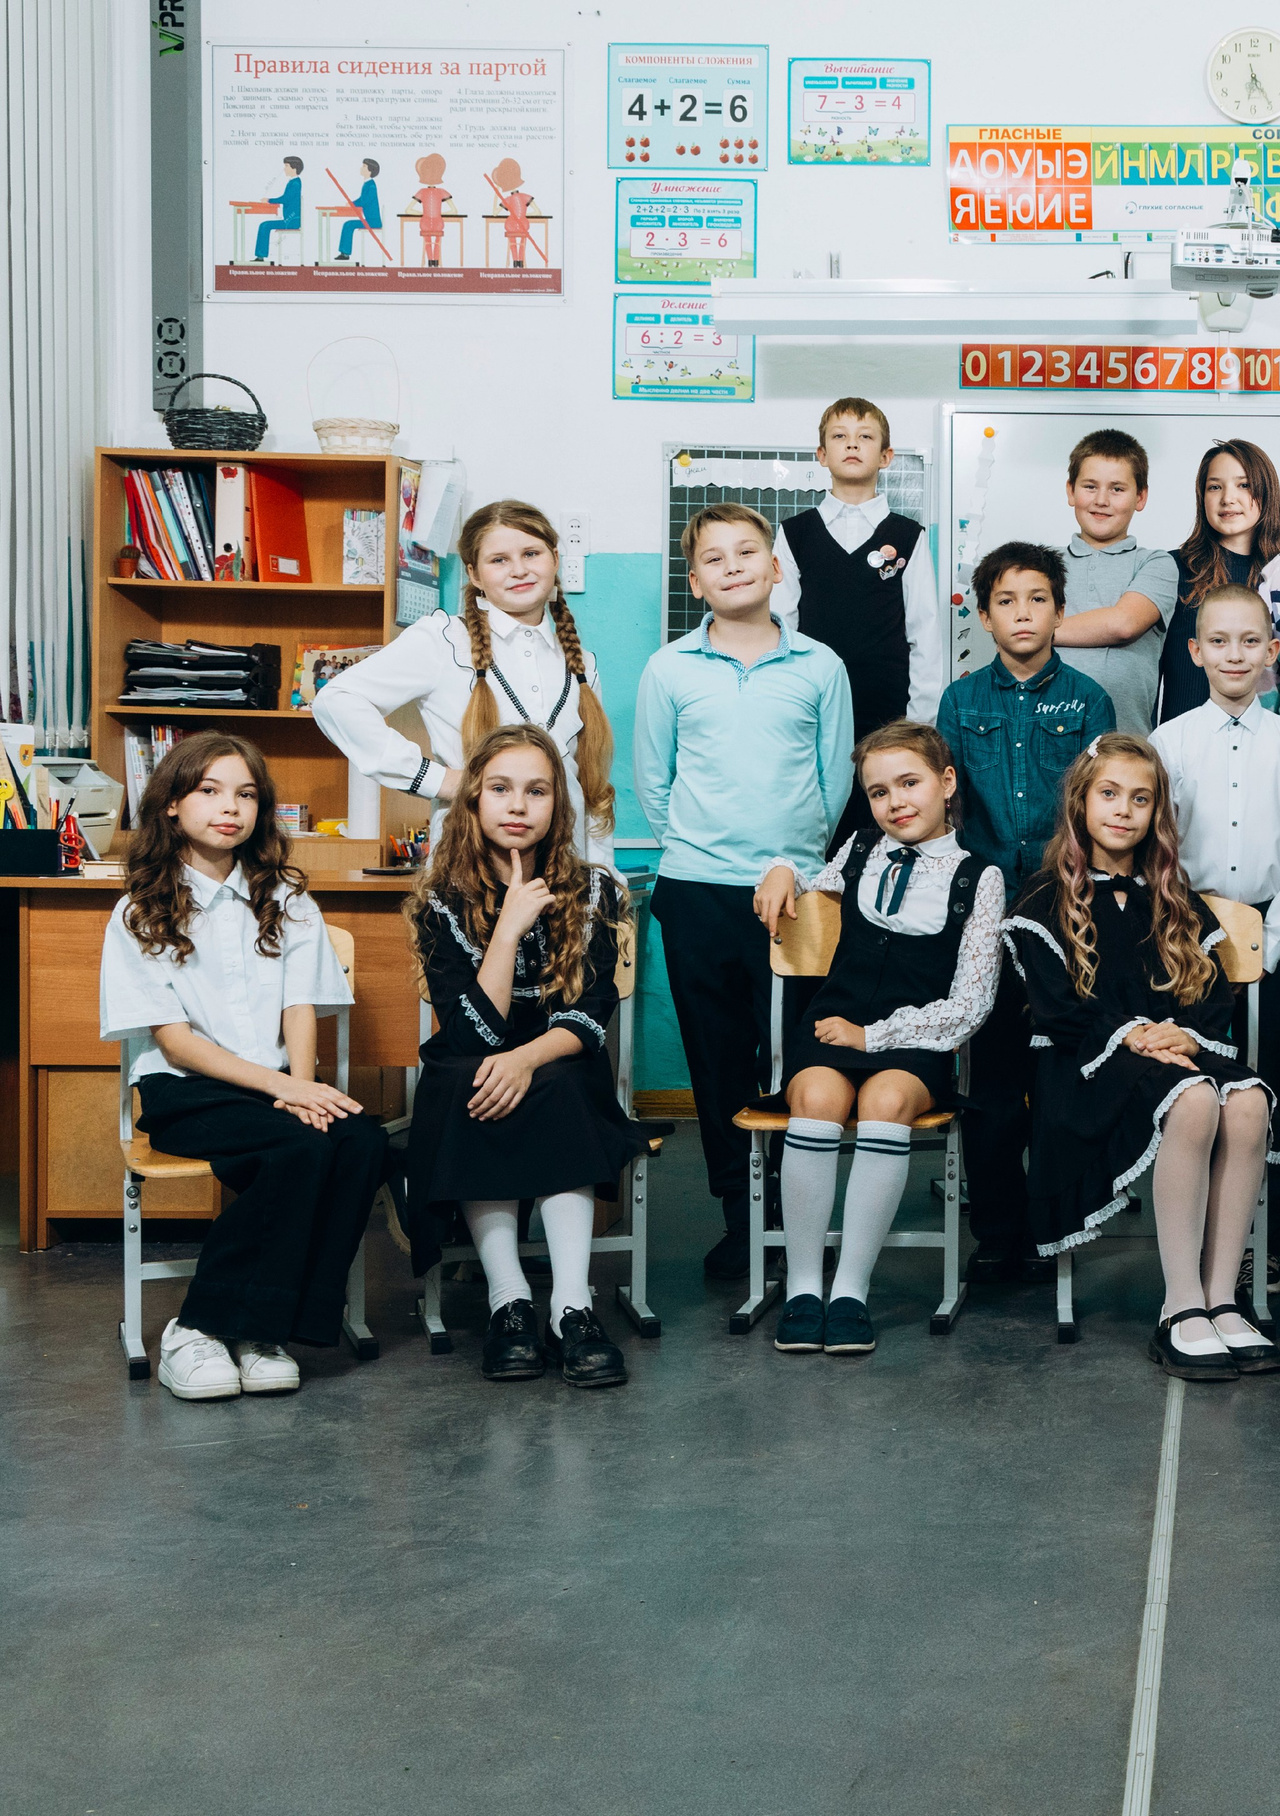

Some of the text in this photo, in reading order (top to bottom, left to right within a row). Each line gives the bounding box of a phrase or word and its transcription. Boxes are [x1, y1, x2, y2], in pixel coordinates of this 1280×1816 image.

[1234, 42, 1241, 52] 11
[1250, 38, 1259, 48] 12
[624, 56, 752, 65] КОМПОНЕНТЫ СЛОЖЕНИЯ
[1222, 54, 1231, 64] 10
[234, 54, 547, 82] Правила сидения за партой
[824, 64, 896, 74] Вычитание
[618, 76, 656, 84] Слагаемое
[668, 76, 708, 84] Слагаемое
[1216, 71, 1222, 80] 9
[726, 78, 750, 86] Сумма
[1221, 88, 1228, 97] 8
[486, 106, 524, 114] раскрытой
[1234, 100, 1240, 110] 7
[1250, 104, 1256, 115] 6
[464, 124, 486, 132] Грудь
[238, 130, 256, 138] Ноги
[979, 128, 1062, 140] ГЛАСНЫЕ
[254, 140, 284, 148] ступнёй
[650, 182, 722, 194] Умножение
[660, 299, 708, 310] Деление
[964, 350, 987, 382] 0
[997, 351, 1012, 382] 1
[1022, 351, 1044, 382] 2
[1050, 351, 1071, 383] 3
[1076, 351, 1100, 383] 4
[1106, 352, 1128, 384] 5
[1134, 352, 1158, 384] 6
[1161, 352, 1183, 384] 7
[1188, 352, 1211, 384] 8
[1216, 352, 1238, 384] 9
[1244, 354, 1271, 386] 10
